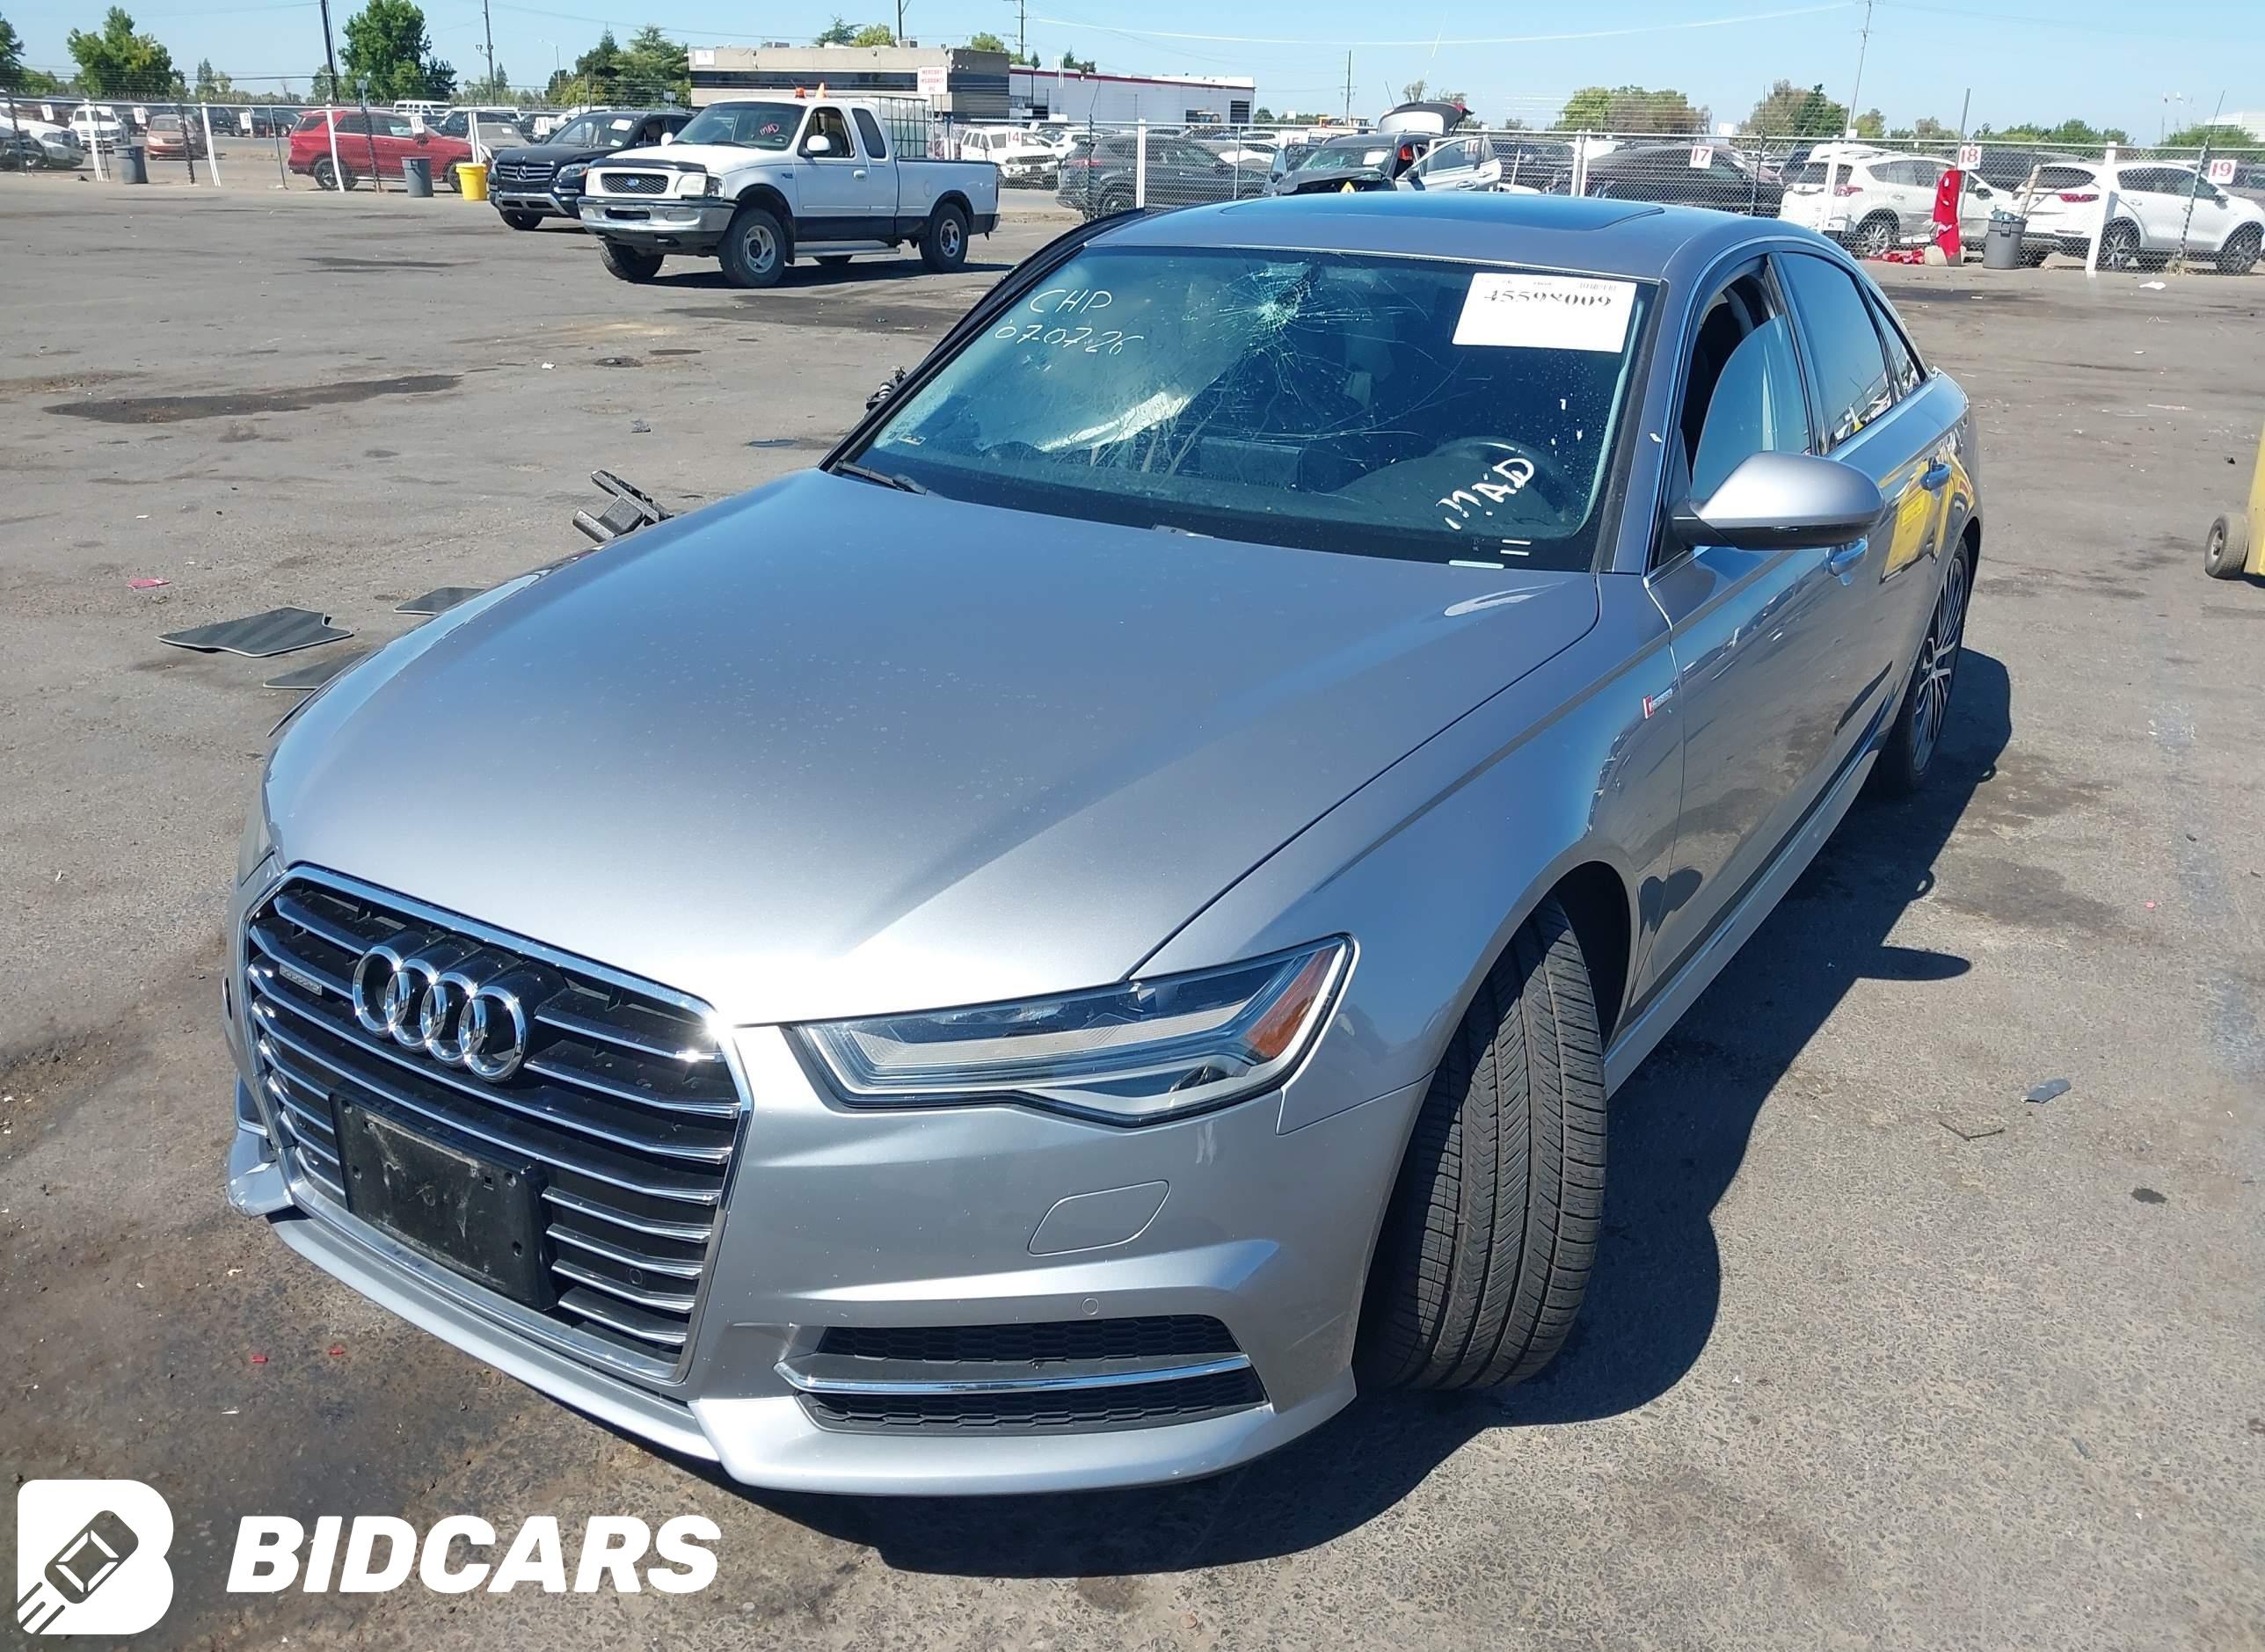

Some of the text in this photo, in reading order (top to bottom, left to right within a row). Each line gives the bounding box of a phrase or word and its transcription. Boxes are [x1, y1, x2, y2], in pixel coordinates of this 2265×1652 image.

[412, 118, 422, 128] 10
[537, 119, 547, 129] 11
[1008, 131, 1020, 142] 14
[1693, 148, 1710, 162] 17
[1960, 148, 1978, 164] 18
[2211, 162, 2232, 177] 19
[1030, 288, 1112, 314] CHP
